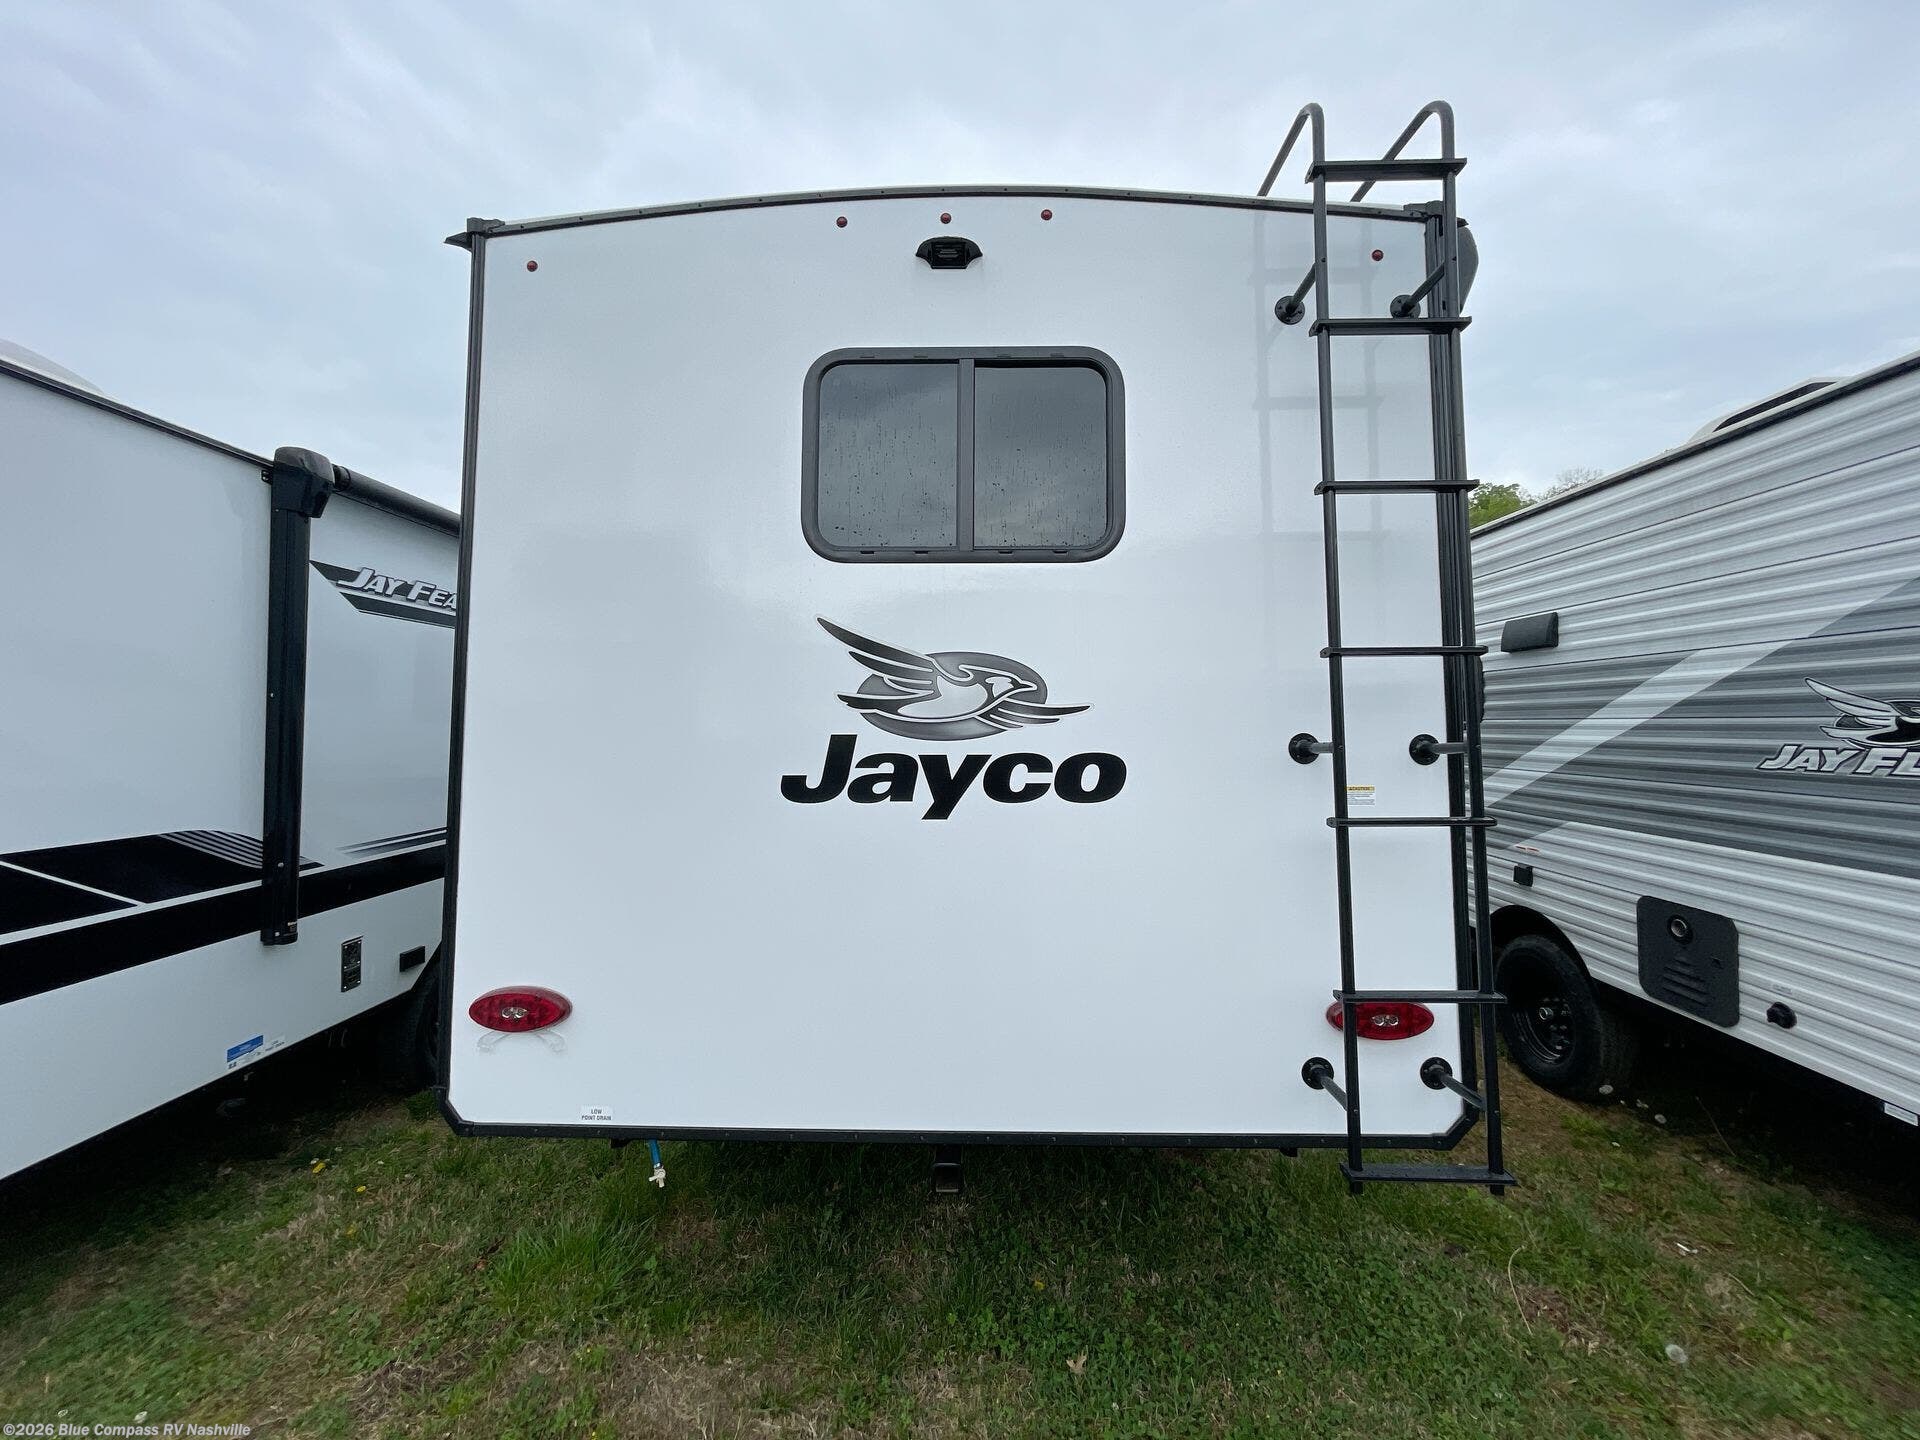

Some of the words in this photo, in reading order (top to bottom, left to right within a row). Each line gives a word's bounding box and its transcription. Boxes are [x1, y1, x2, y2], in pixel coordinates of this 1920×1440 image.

[336, 567, 408, 598] JAY
[1756, 743, 1866, 772] JAY
[780, 734, 1127, 820] Jayco
